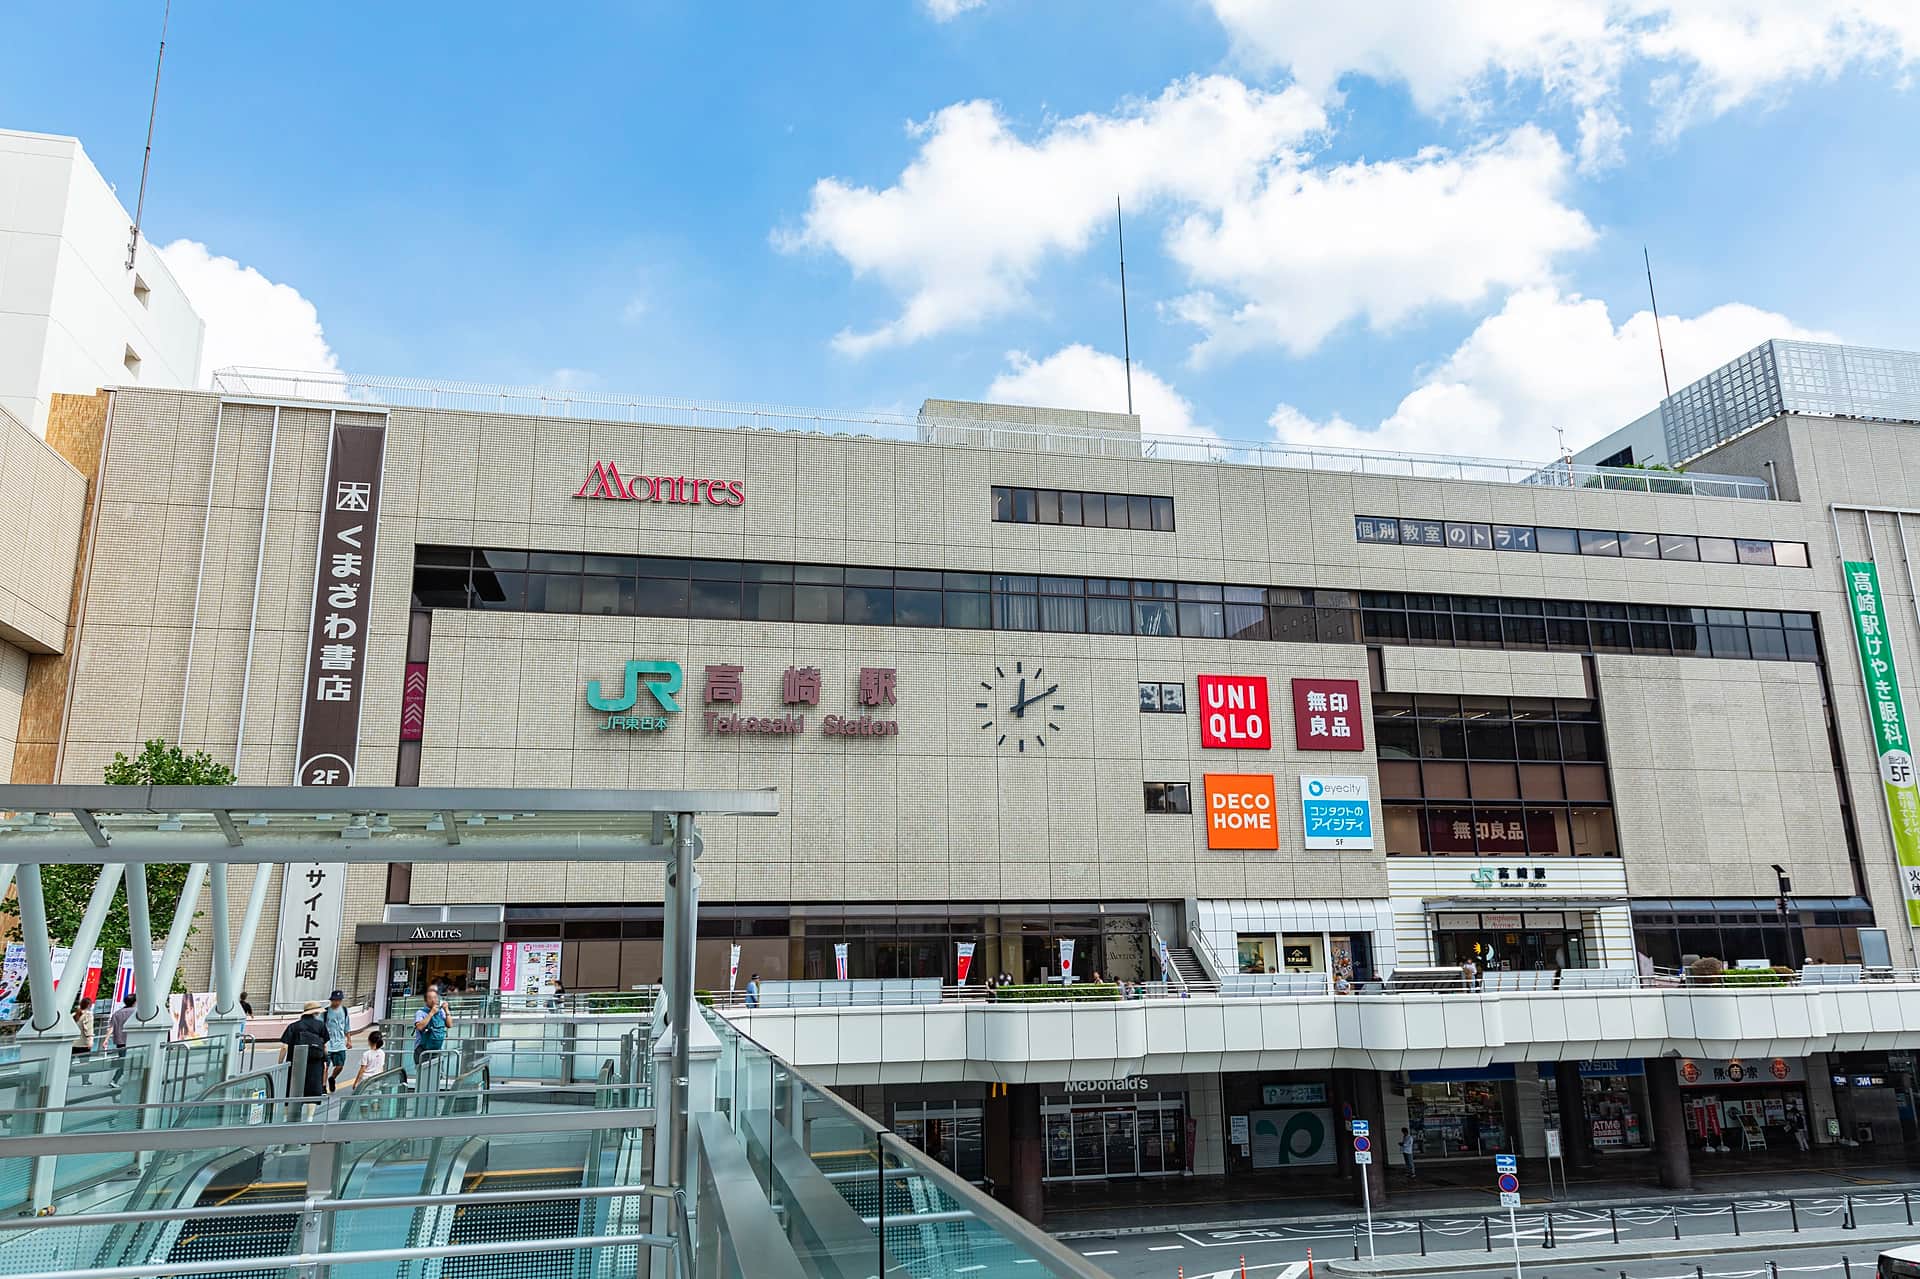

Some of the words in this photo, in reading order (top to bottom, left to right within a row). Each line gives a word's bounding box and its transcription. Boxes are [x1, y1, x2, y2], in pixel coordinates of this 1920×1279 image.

[572, 460, 745, 506] Montres
[1356, 521, 1531, 548] 個別教室のトライ
[316, 524, 364, 701] くまざわ書店
[1852, 570, 1903, 746] 高崎駅けやき眼科
[586, 660, 683, 712] JR
[703, 663, 897, 706] 高崎駅
[1207, 683, 1256, 709] UNI
[1306, 690, 1348, 713] 無印
[598, 716, 669, 732] JR東日本
[703, 711, 805, 734] Takasaki
[823, 714, 898, 735] Station
[1209, 713, 1262, 743] QLO
[1309, 716, 1351, 737] 良品
[311, 769, 340, 785] 2F
[1890, 765, 1911, 783] 5F
[1324, 783, 1361, 796] eyecity
[1212, 793, 1270, 809] DECO
[1214, 813, 1271, 829] HOME
[1310, 806, 1364, 817] コンタクトの
[1311, 817, 1364, 831] アイシティ
[1452, 820, 1525, 840] 無印良品
[1335, 838, 1344, 846] 5F
[1470, 867, 1494, 883] JR
[294, 863, 326, 981] サイト高崎
[409, 927, 464, 939] Montres
[1063, 1077, 1149, 1092] McDonald's
